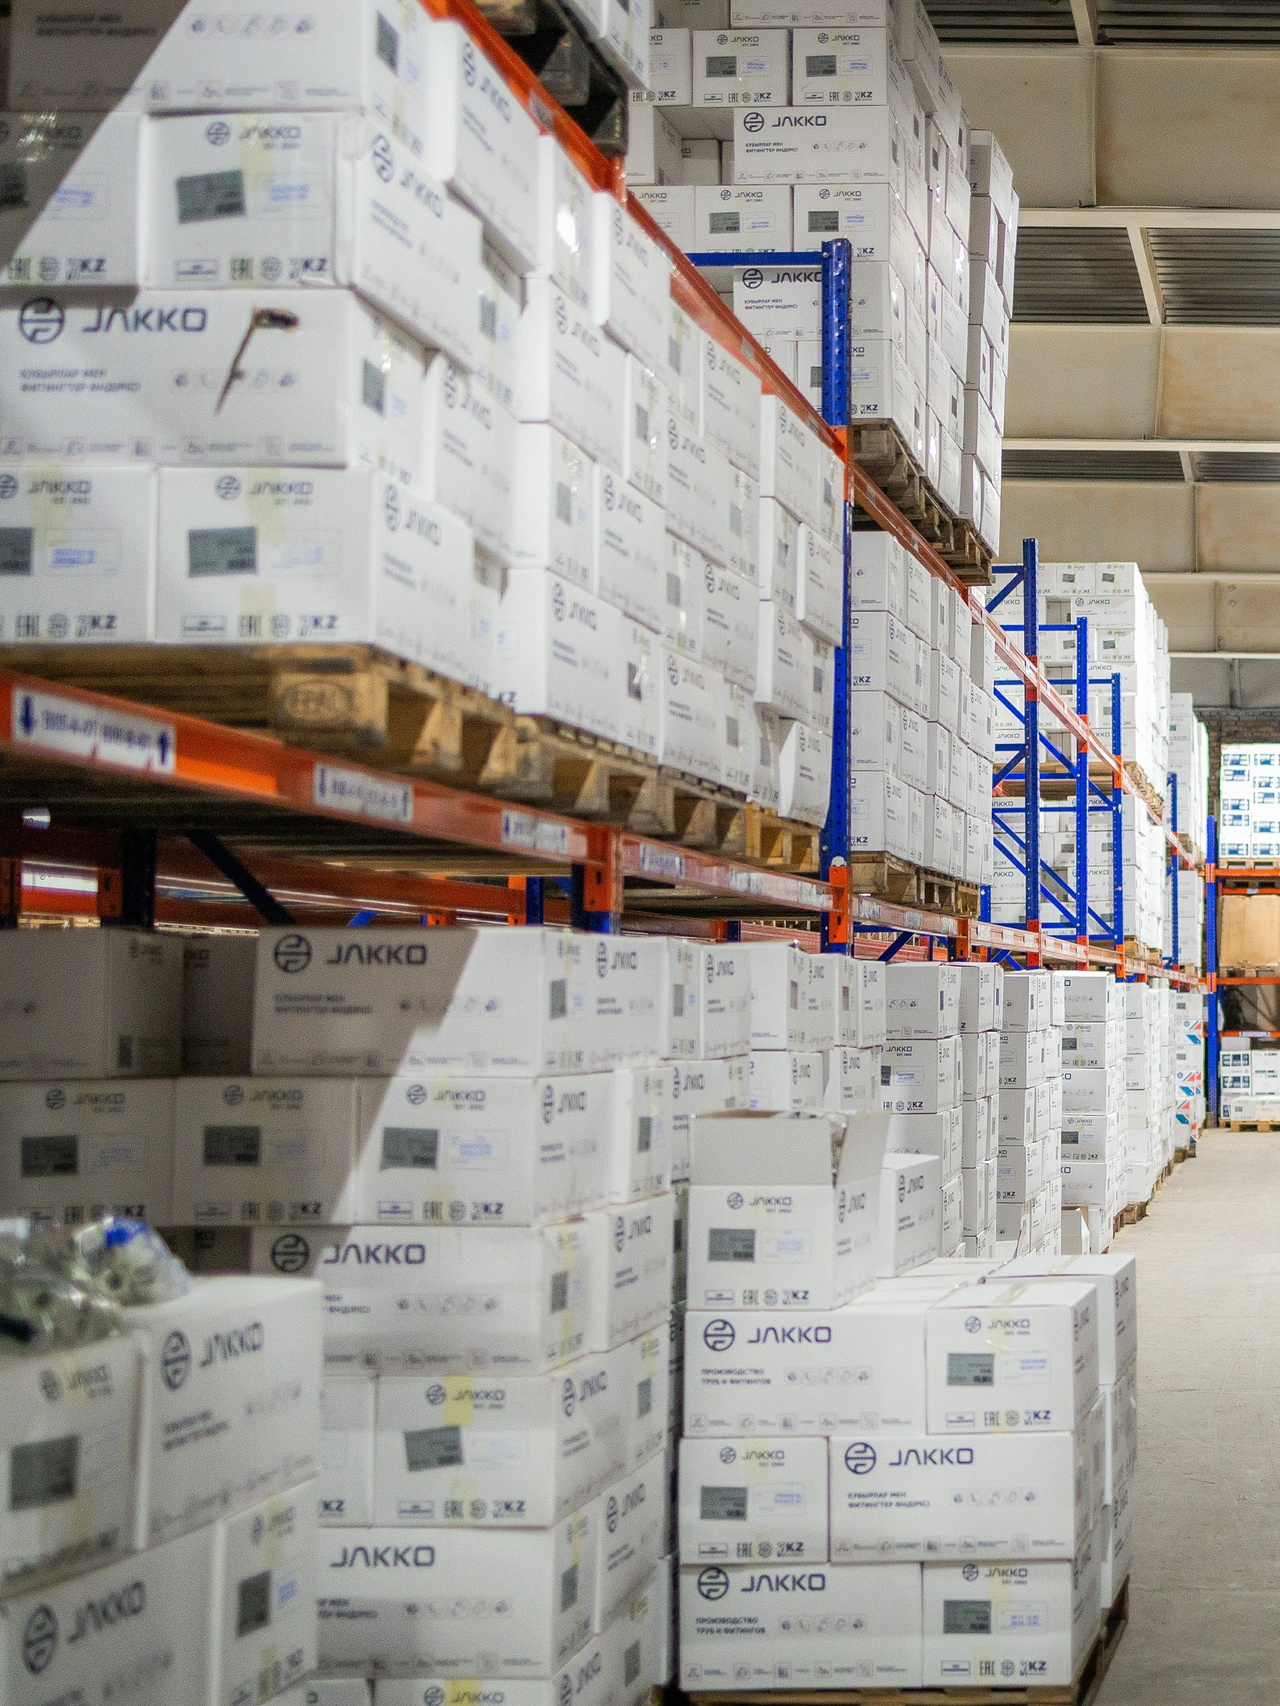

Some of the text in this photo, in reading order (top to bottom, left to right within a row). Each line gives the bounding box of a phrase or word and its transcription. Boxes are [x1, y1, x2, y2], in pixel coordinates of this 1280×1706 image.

[832, 34, 859, 42] JAKKO
[760, 92, 771, 100] KZ
[861, 91, 872, 99] KZ
[772, 115, 827, 127] JAKKO
[239, 126, 302, 141] JAKKO
[83, 307, 207, 332] JAKKO
[866, 404, 878, 412] KZ
[326, 945, 426, 965] JAKKO
[250, 1089, 303, 1101] JAKKO
[432, 1089, 486, 1102] JAKKO
[749, 1196, 792, 1206] JAKKO
[323, 1244, 425, 1264] JAKKO
[791, 1290, 809, 1300] KZ
[987, 1318, 1030, 1329] JAKKO
[748, 1326, 831, 1344] JAKKO
[455, 1389, 505, 1402] JAKKO
[1032, 1411, 1051, 1420] KZ
[742, 1450, 785, 1460] JAKKO
[889, 1448, 973, 1466] JAKKO
[504, 1500, 525, 1513] KZ
[786, 1542, 804, 1553] KZ
[331, 1546, 434, 1568] JAKKO
[985, 1568, 1028, 1577] JAKKO
[741, 1573, 826, 1592] JAKKO
[1029, 1661, 1046, 1671] KZ
[448, 1691, 504, 1704] JAKKO
